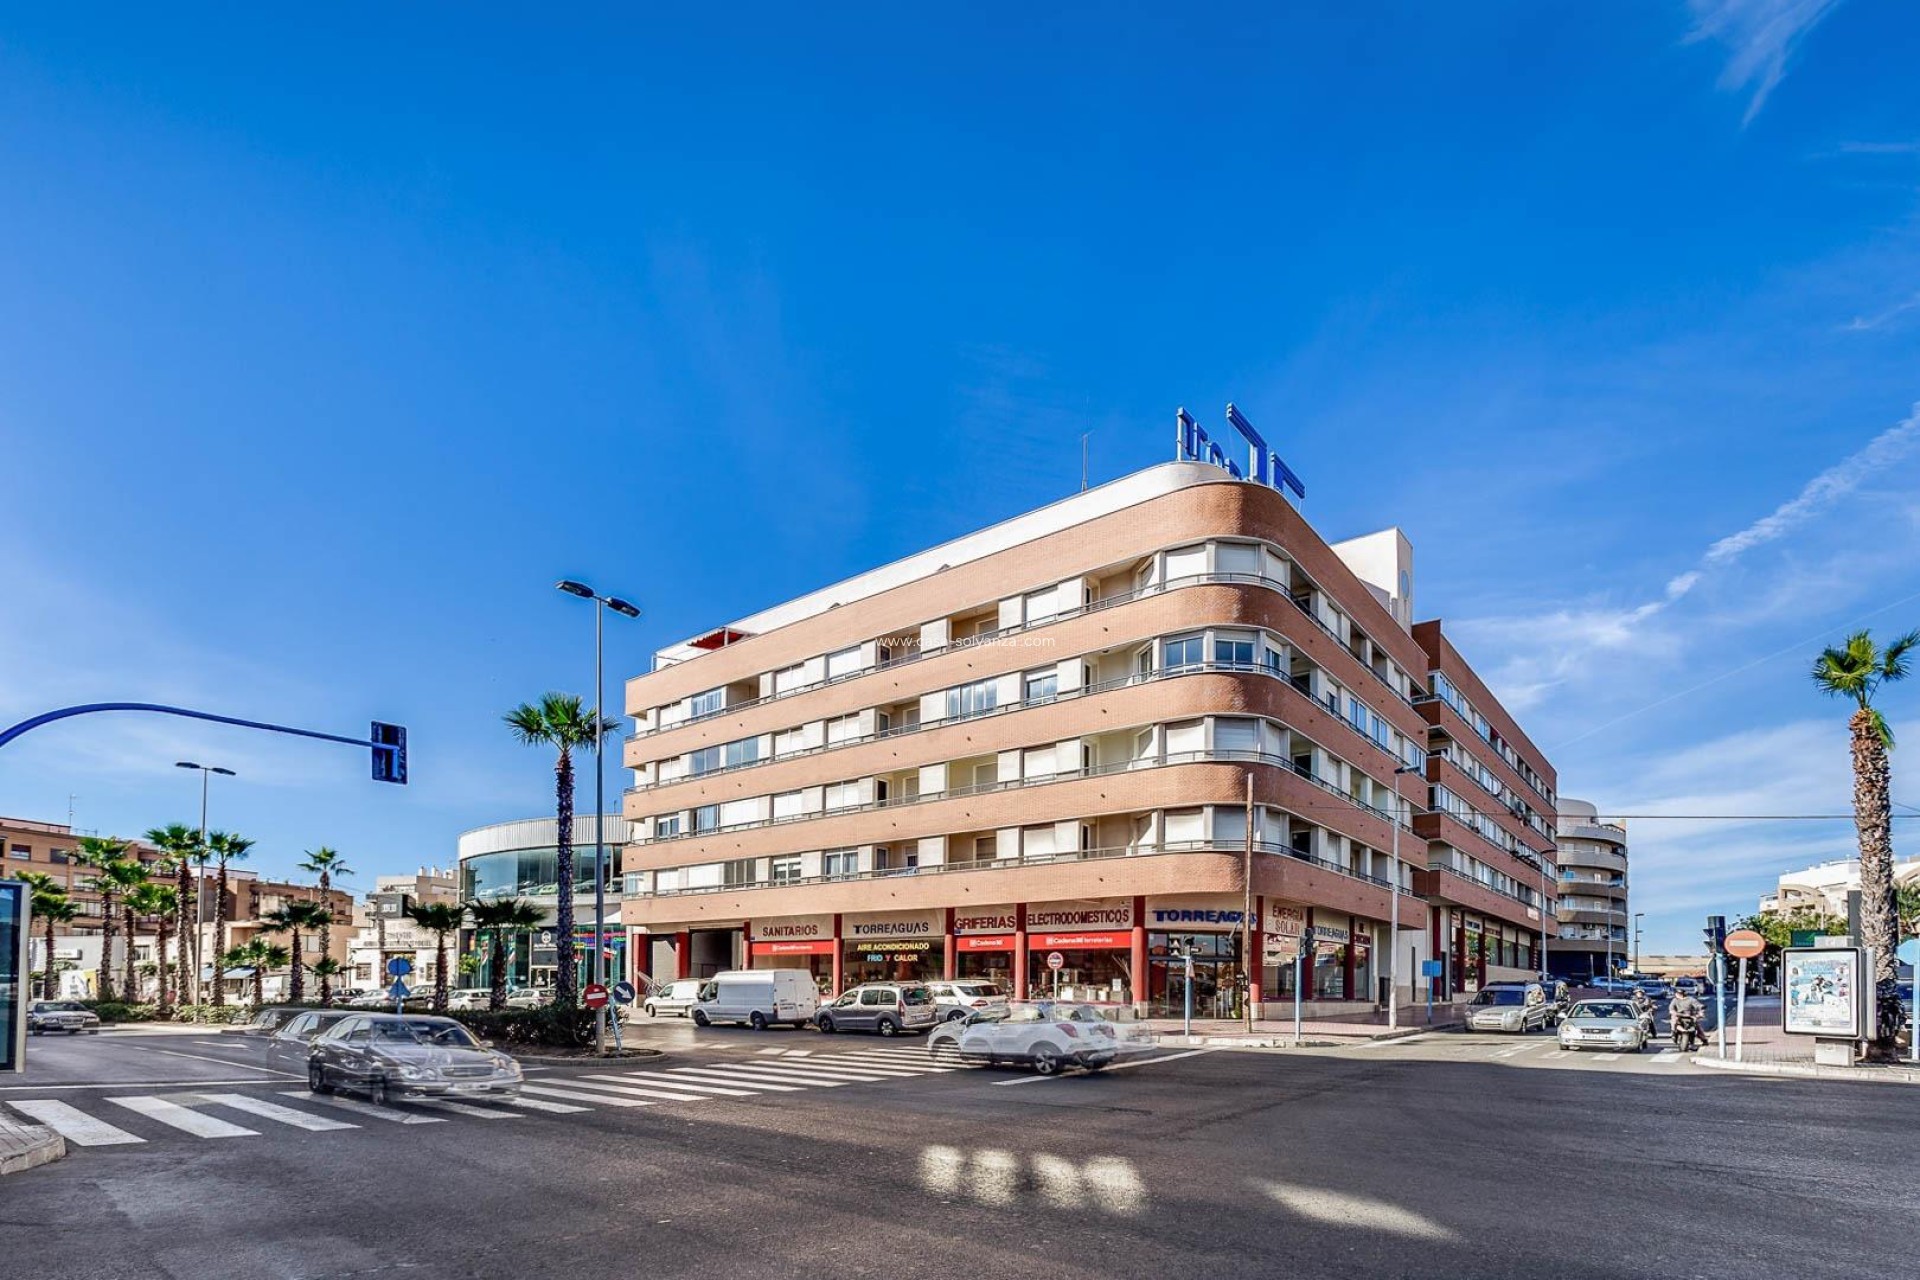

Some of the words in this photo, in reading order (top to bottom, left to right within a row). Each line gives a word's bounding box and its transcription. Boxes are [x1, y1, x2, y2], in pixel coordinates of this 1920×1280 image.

[955, 915, 1015, 929] GRIFERIAS
[1027, 909, 1129, 925] ELECTRODOMESTICOS
[762, 925, 818, 936] SANITARIOS
[853, 922, 929, 935] TORREAGUAS
[857, 943, 872, 951] AIRE
[873, 942, 930, 951] ACONDICIONADO
[867, 954, 883, 962] FRIO
[893, 954, 918, 962] CALOR
